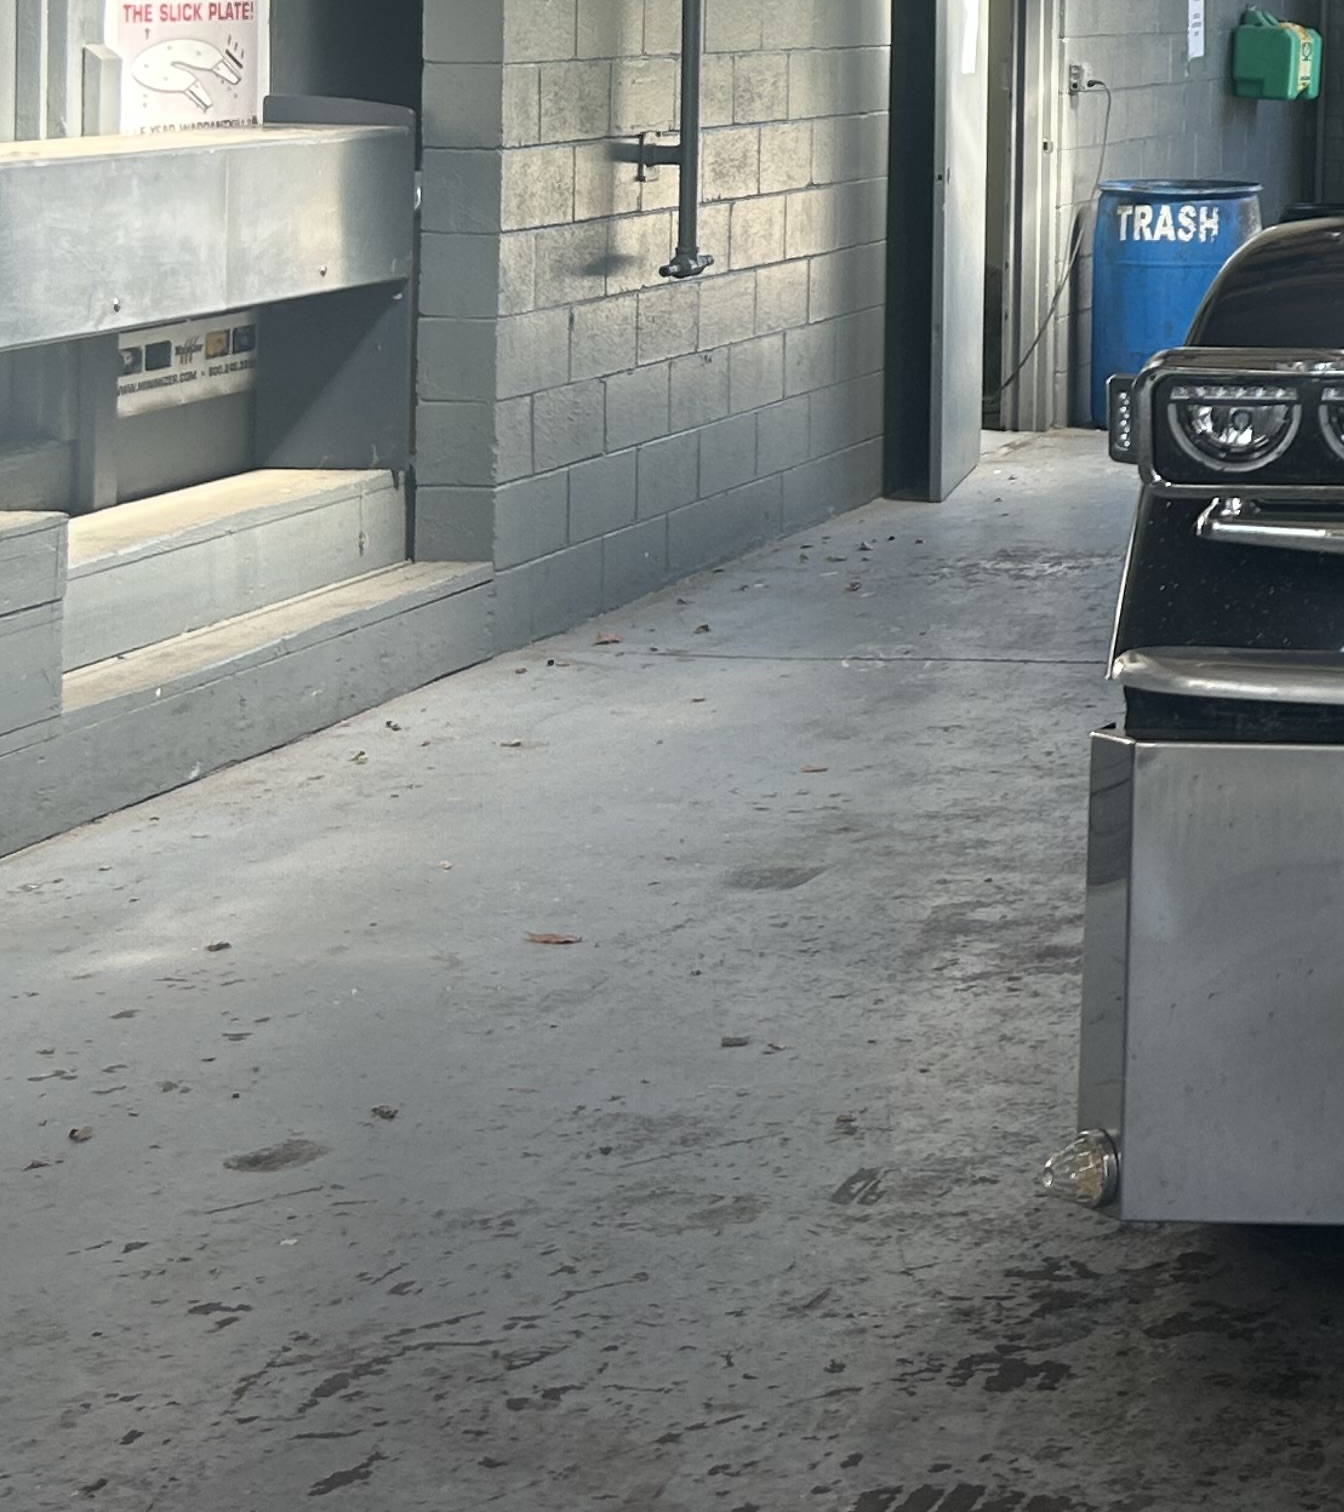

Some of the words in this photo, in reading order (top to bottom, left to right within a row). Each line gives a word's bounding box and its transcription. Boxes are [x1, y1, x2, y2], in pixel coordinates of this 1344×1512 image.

[123, 4, 153, 23] THE
[160, 3, 203, 21] SLICK
[208, 1, 254, 20] PLATE!
[1116, 204, 1219, 244] TRASH
